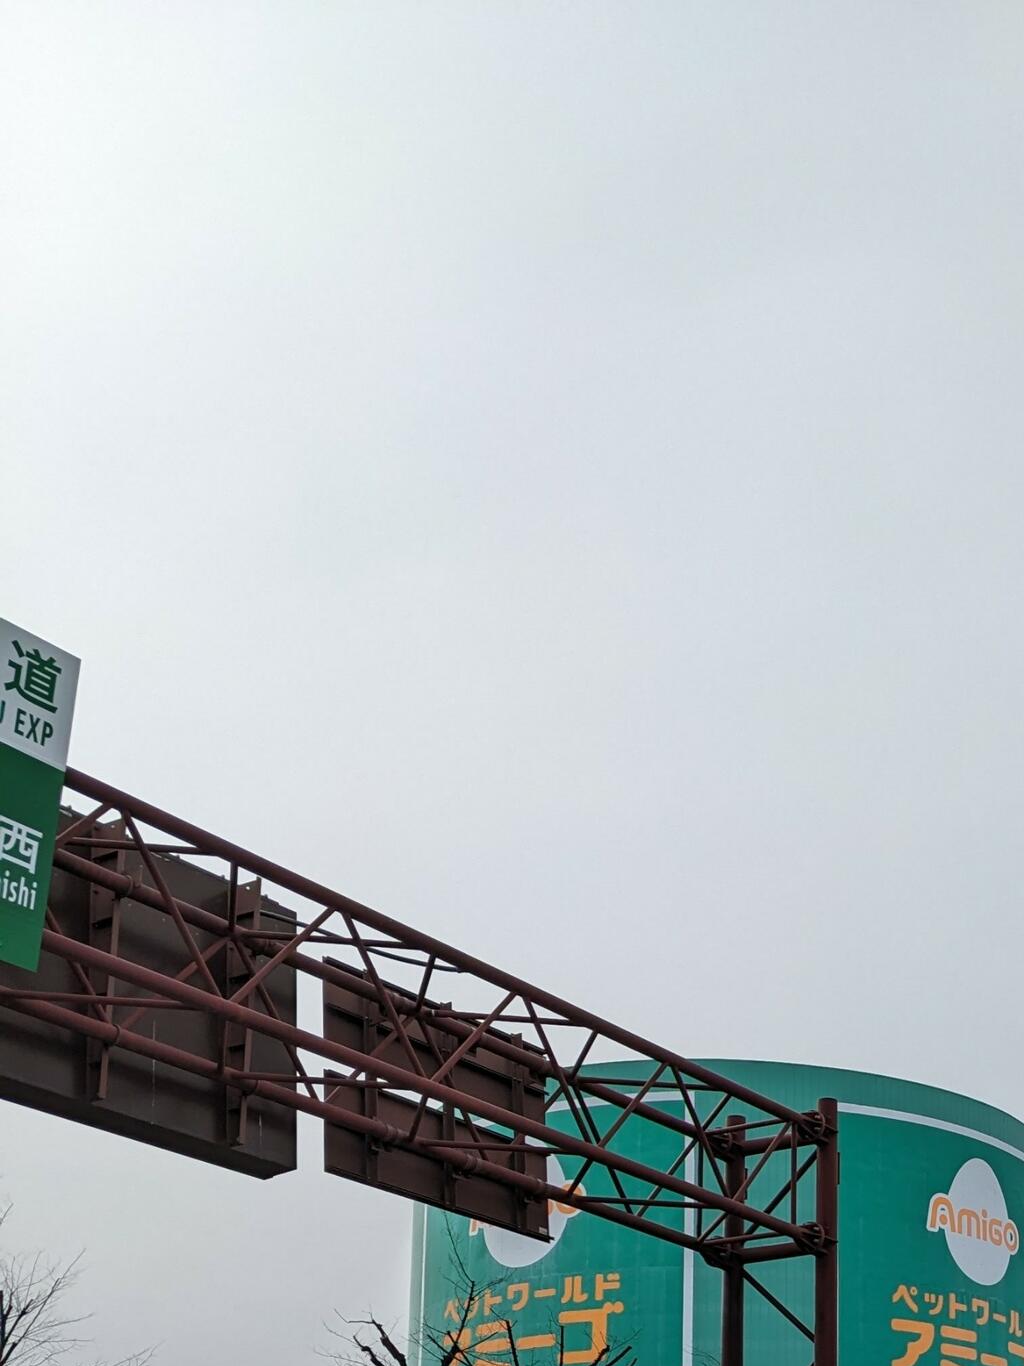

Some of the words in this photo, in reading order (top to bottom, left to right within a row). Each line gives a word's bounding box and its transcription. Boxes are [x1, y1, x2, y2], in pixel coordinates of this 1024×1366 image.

[4, 639, 62, 714] 道
[14, 707, 54, 747] EXP
[0, 814, 43, 875] 西
[0, 869, 38, 911] ishi
